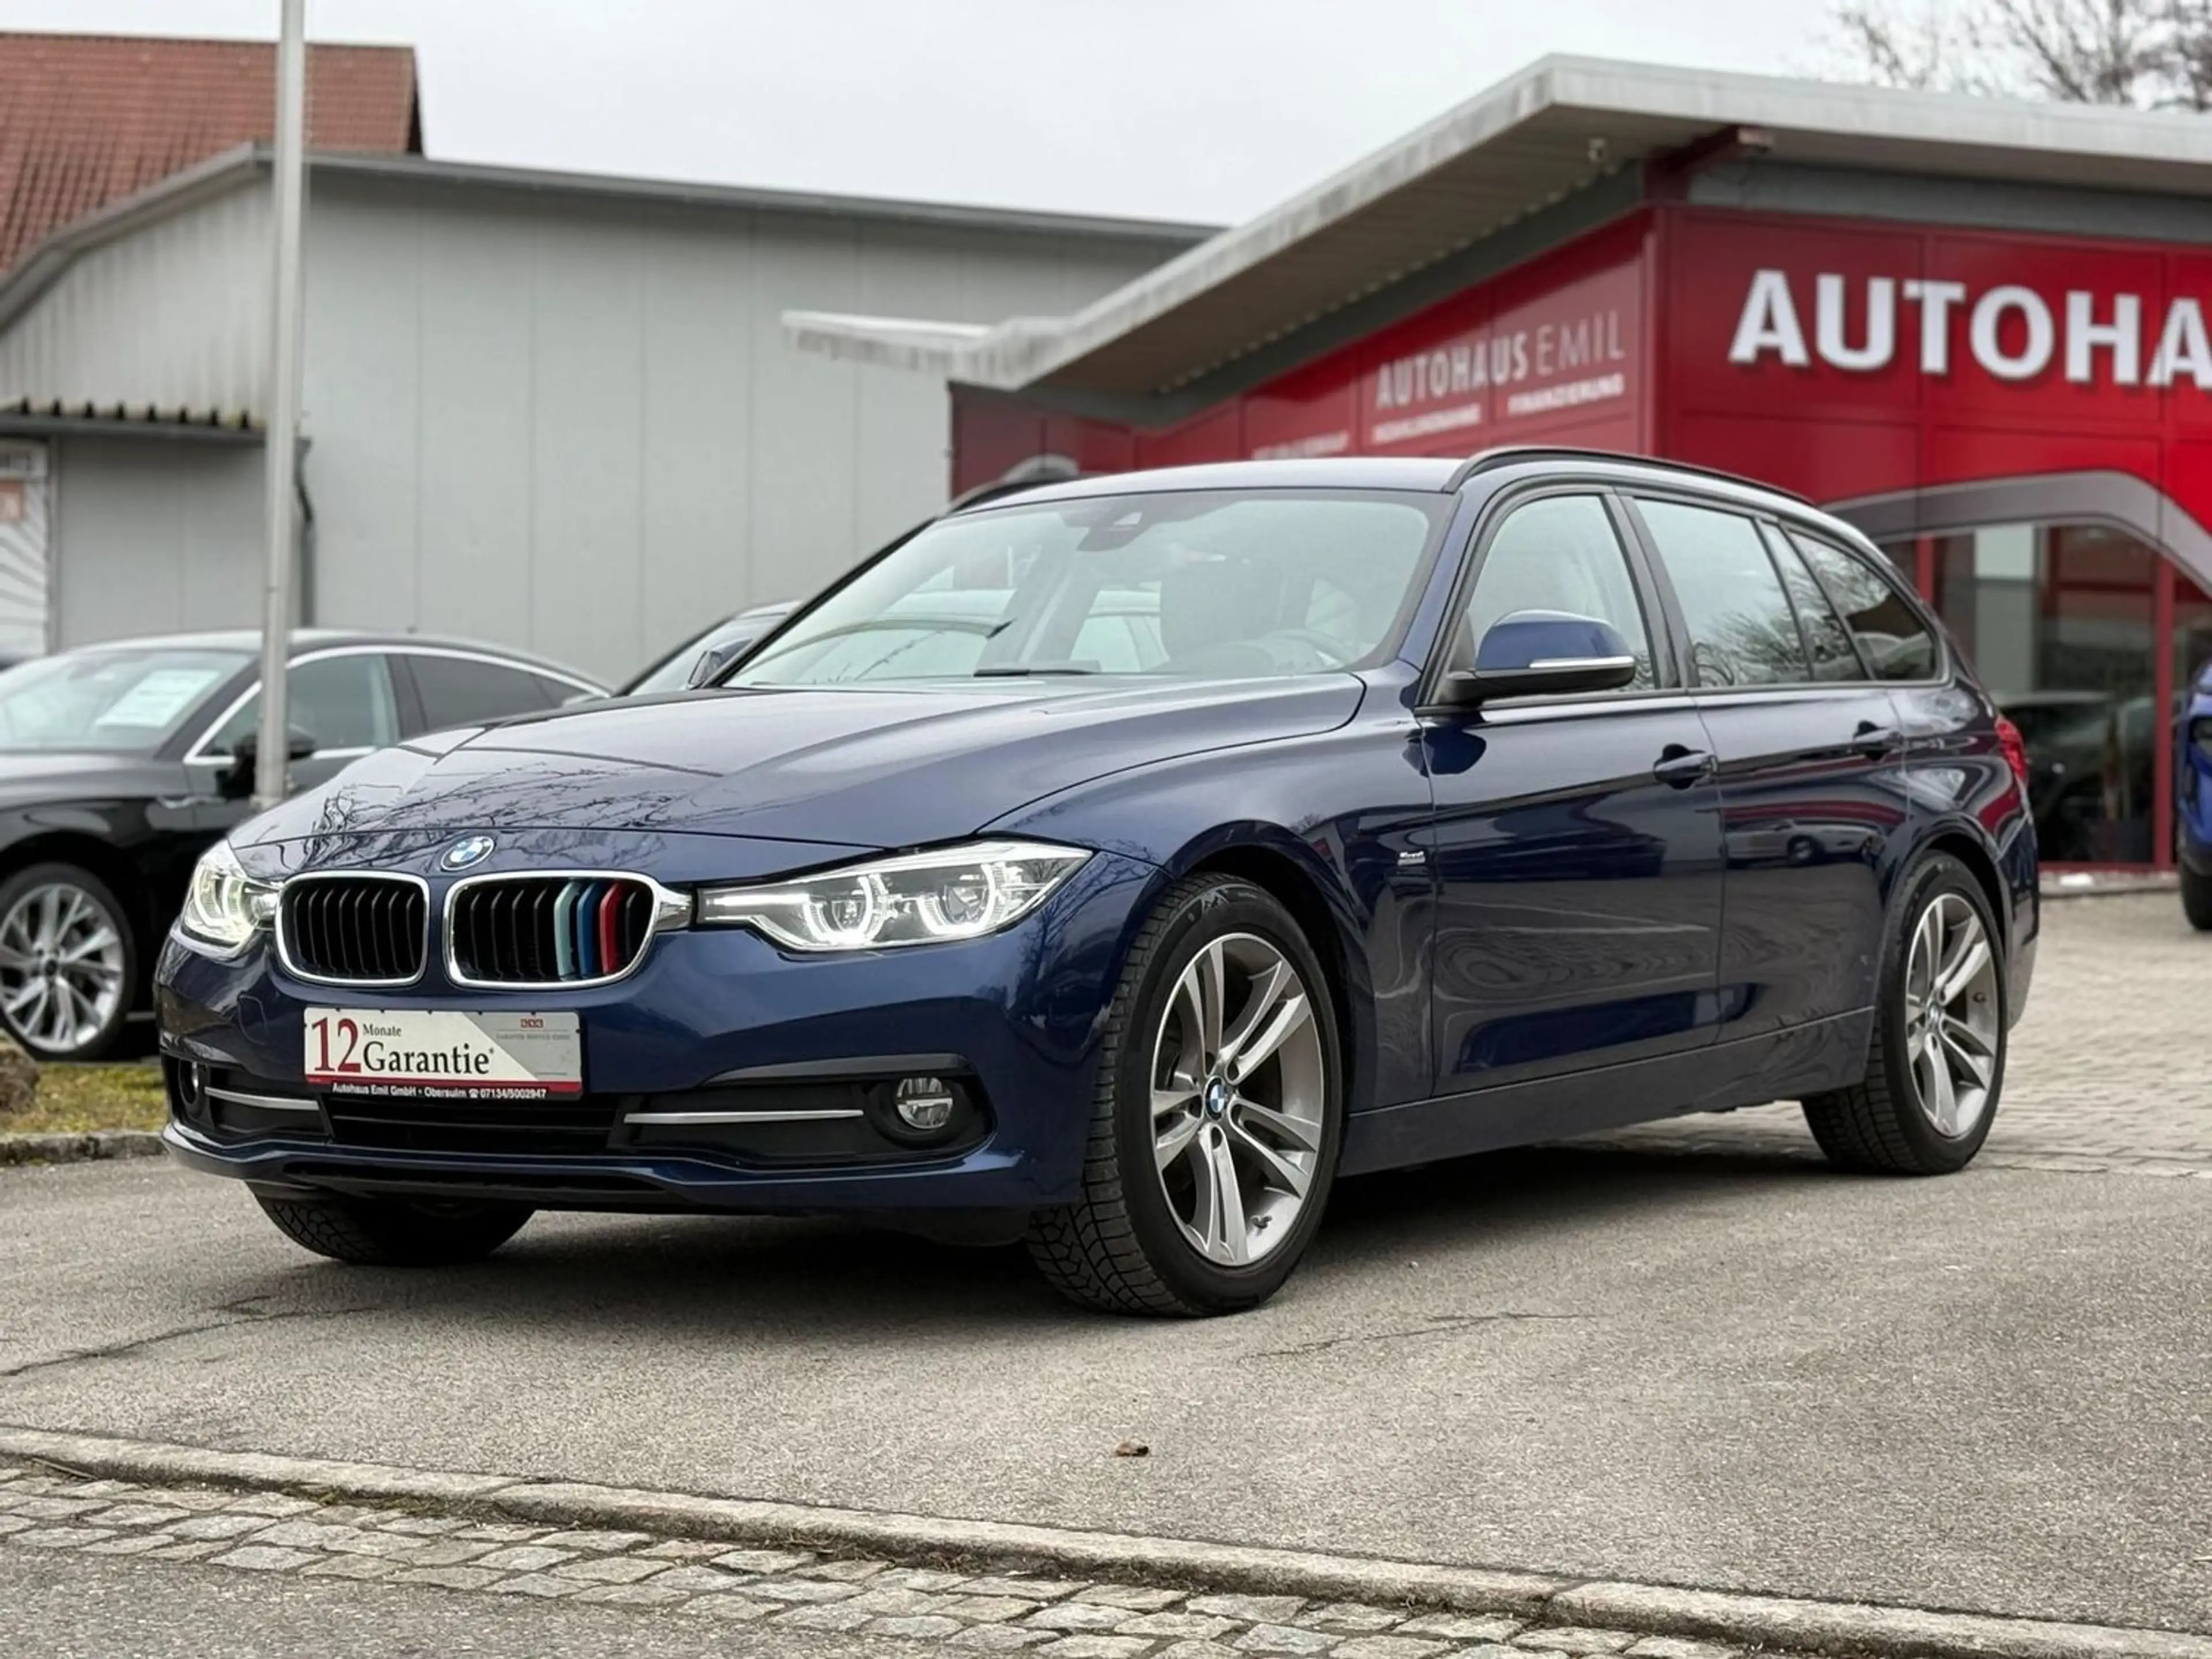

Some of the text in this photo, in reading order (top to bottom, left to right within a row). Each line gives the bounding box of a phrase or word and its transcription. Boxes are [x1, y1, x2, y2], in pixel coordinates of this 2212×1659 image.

[1728, 270, 2212, 389] AUTOHA
[1376, 311, 1626, 409] AUTOHAUS EMIL
[312, 1016, 361, 1073] 12
[363, 1023, 402, 1037] Monate
[363, 1040, 490, 1074] Garantie
[332, 1082, 369, 1094] Autohaus
[370, 1084, 389, 1094] Emil
[391, 1085, 416, 1096] GmbH
